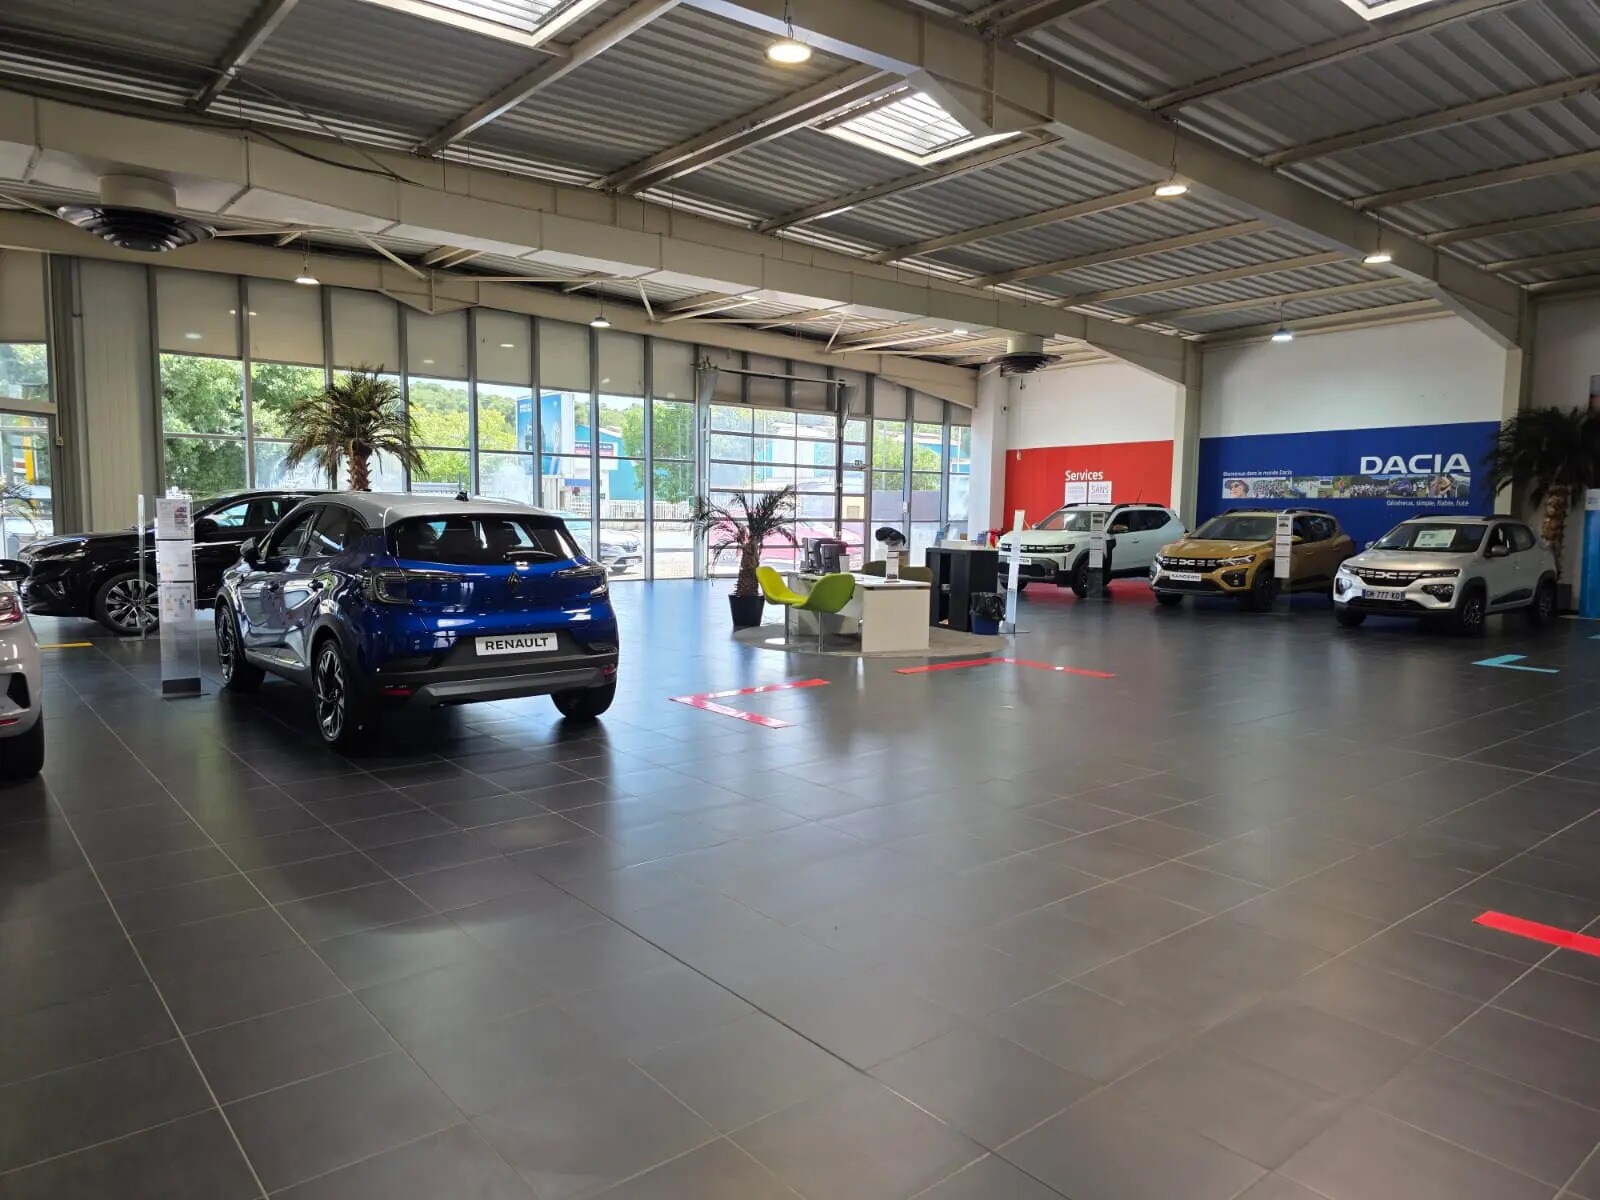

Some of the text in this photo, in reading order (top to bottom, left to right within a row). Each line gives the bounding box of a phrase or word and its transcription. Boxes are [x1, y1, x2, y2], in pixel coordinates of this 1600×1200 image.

[1360, 453, 1471, 474] DACIA
[1064, 469, 1104, 481] Services
[485, 637, 548, 651] RENAULT
